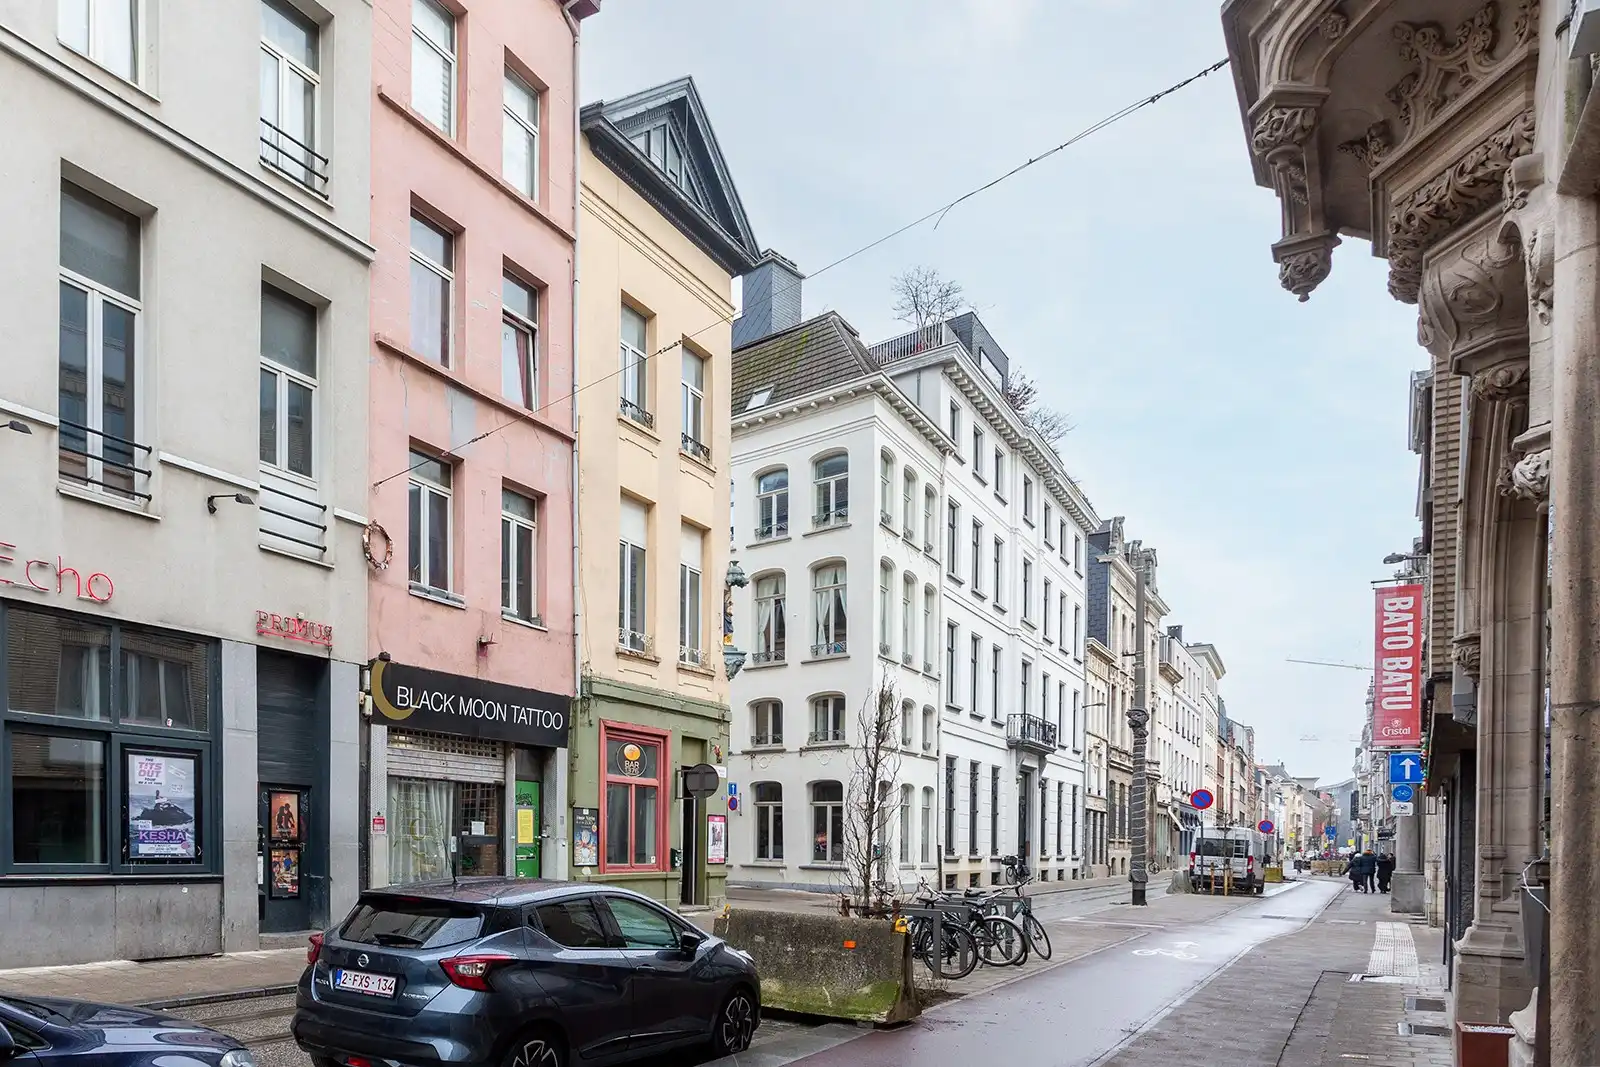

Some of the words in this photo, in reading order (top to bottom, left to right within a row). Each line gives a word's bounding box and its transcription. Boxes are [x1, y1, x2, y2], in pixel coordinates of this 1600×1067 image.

[256, 610, 332, 641] PRIMUS
[1382, 596, 1414, 651] BATO
[1381, 656, 1413, 710] BATU
[397, 685, 455, 715] BLACK
[459, 695, 507, 722] MOON
[511, 704, 563, 730] TATTOO
[1382, 726, 1411, 737] Cristal
[138, 761, 162, 770] TITS
[624, 760, 640, 769] BAR
[139, 831, 185, 840] KESHA
